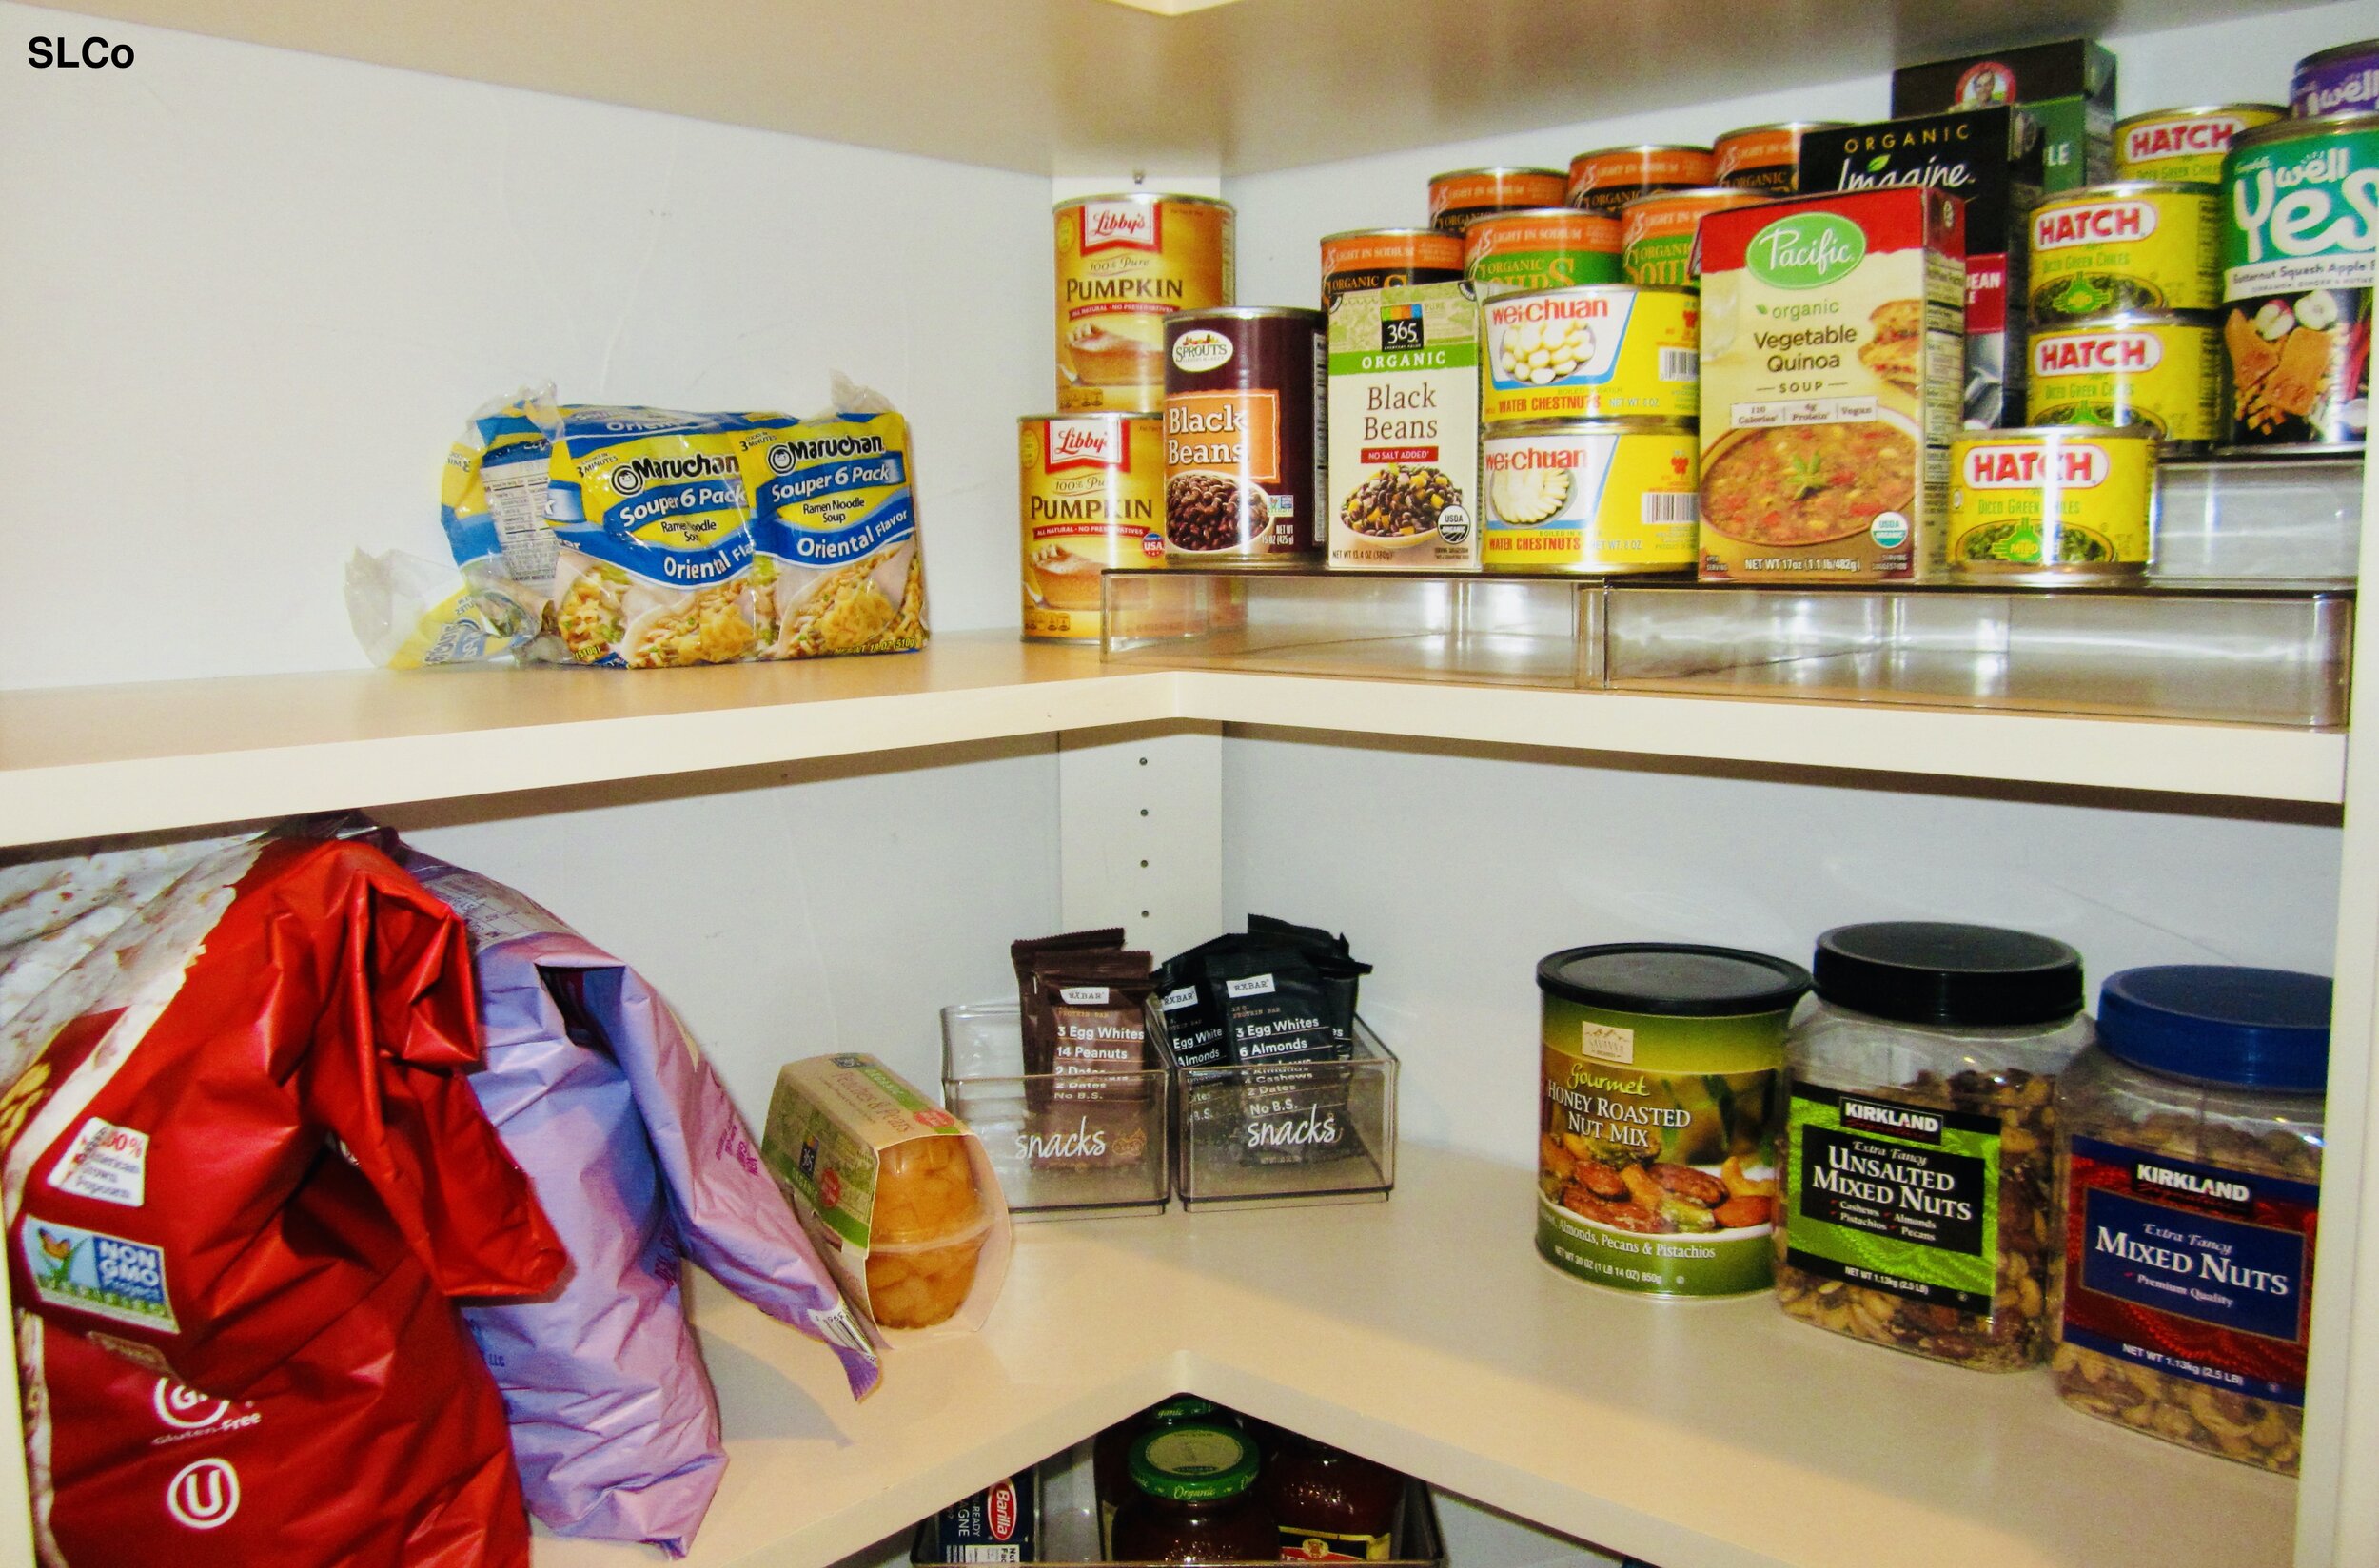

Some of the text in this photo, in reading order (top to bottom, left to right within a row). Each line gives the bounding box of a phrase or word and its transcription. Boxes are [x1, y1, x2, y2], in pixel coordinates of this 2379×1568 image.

[1844, 124, 1970, 153] ORGANIC
[2131, 124, 2233, 157] HATCH
[2275, 148, 2349, 188] well
[1093, 209, 1146, 237] Libby's
[2234, 168, 2377, 263] Yes
[2039, 208, 2141, 245] HATCH
[1120, 255, 1150, 268] Pure
[1760, 228, 1852, 274] Pacific
[1487, 259, 1544, 275] ORGANIC
[2280, 260, 2368, 280] Squash Apple
[1066, 278, 1183, 302] PUMPKIN
[1332, 276, 1380, 289] ORGANIC
[1492, 298, 1608, 325] wei-chuan
[1773, 300, 1839, 321] organic
[1387, 323, 1418, 344] 365
[1754, 324, 1858, 350] Vegetable
[1175, 343, 1227, 362] SPROUTS
[1362, 351, 1445, 370] ORGANIC
[2040, 340, 2146, 370] HATCH
[1767, 354, 1841, 373] Quinoa
[1367, 382, 1437, 411] Black
[1779, 382, 1823, 394] SOUP
[2070, 382, 2098, 397] GREEN
[1499, 396, 1601, 413] WATER CHESTNUS
[1169, 404, 1248, 434] Black
[1365, 416, 1437, 441] Beans
[739, 441, 748, 452] 3
[788, 436, 883, 461] Maruchan
[1169, 439, 1249, 465] Beans
[1368, 451, 1398, 461] NO SALT
[577, 466, 584, 478] 3
[631, 454, 740, 480] Maruchan
[1974, 452, 2093, 482] HATH
[772, 464, 890, 502] Souper 6 Pack
[1055, 480, 1083, 491] 100%
[619, 485, 747, 527] Souper 6 Pack
[803, 497, 865, 515] Ramen Noodle
[1978, 498, 2041, 514] DICED GREEN
[822, 511, 846, 524] Soup
[1445, 515, 1463, 523] USDA
[797, 509, 909, 559] Oriental Flavor
[1047, 526, 1073, 535] NATURAL
[1144, 541, 1163, 551] USA
[1332, 550, 1343, 559] NET
[1365, 549, 1372, 558] OZ
[1489, 537, 1581, 550] WATER CHESTNUTS
[663, 549, 731, 579] Oriental
[1745, 559, 1763, 570] NET
[1765, 559, 1780, 570] WT
[1782, 559, 1802, 571] 17oz
[1234, 981, 1268, 991] RXBAR
[1164, 992, 1193, 1005] RXBAR
[1057, 1026, 1144, 1040] 3 Egg Whites
[1236, 1017, 1319, 1038] 3 Egg Whites
[1056, 1047, 1128, 1060] 14 Peanuts
[1173, 1036, 1194, 1051] Egg
[1239, 1038, 1308, 1058] 6 Almonds
[1177, 1049, 1220, 1067] Almonds
[1256, 1072, 1313, 1084] Cashews
[1567, 1063, 1651, 1096] Gourmet
[1248, 1084, 1297, 1096] 2 Dates
[1249, 1098, 1297, 1116] No B.S.
[1548, 1079, 1691, 1128] HONEY ROASTED
[1248, 1103, 1336, 1147] snacks
[1845, 1102, 1939, 1133] KIRKLAND
[1014, 1116, 1106, 1161] snacks
[1568, 1111, 1650, 1147] NUT MIX
[1852, 1141, 1928, 1167] Extra Fancy
[1828, 1145, 1956, 1192] UNSALTED
[2137, 1163, 2251, 1203] KIRKLAND
[1812, 1166, 1973, 1222] MIXED NUTS
[1838, 1200, 1880, 1218] Cashews
[1840, 1211, 1888, 1231] Pistachios
[1894, 1212, 1937, 1230] Almonds
[1559, 1220, 1599, 1245] Almonds,
[1602, 1236, 1639, 1253] Pecans
[1642, 1242, 1653, 1256] &
[1656, 1245, 1716, 1259] Pistachios
[1901, 1226, 1937, 1242] Pecans
[2143, 1223, 2234, 1256] Extra Fancy
[98, 1240, 156, 1268] NON
[2095, 1225, 2289, 1296] MIXED NUTS
[98, 1258, 160, 1286] GMO
[1584, 1259, 1640, 1282] OZ LB 14 OZ)
[1844, 1266, 1858, 1278] NET
[1860, 1269, 1873, 1281] WT
[2137, 1274, 2234, 1307] Premium Quality
[2122, 1343, 2244, 1386] NET WT 1.13kg (2.5 LB)
[220, 1412, 263, 1431] Free
[1157, 1409, 1185, 1419] ganic
[1173, 1485, 1216, 1500] Organic
[996, 1490, 1011, 1535] Barilla
